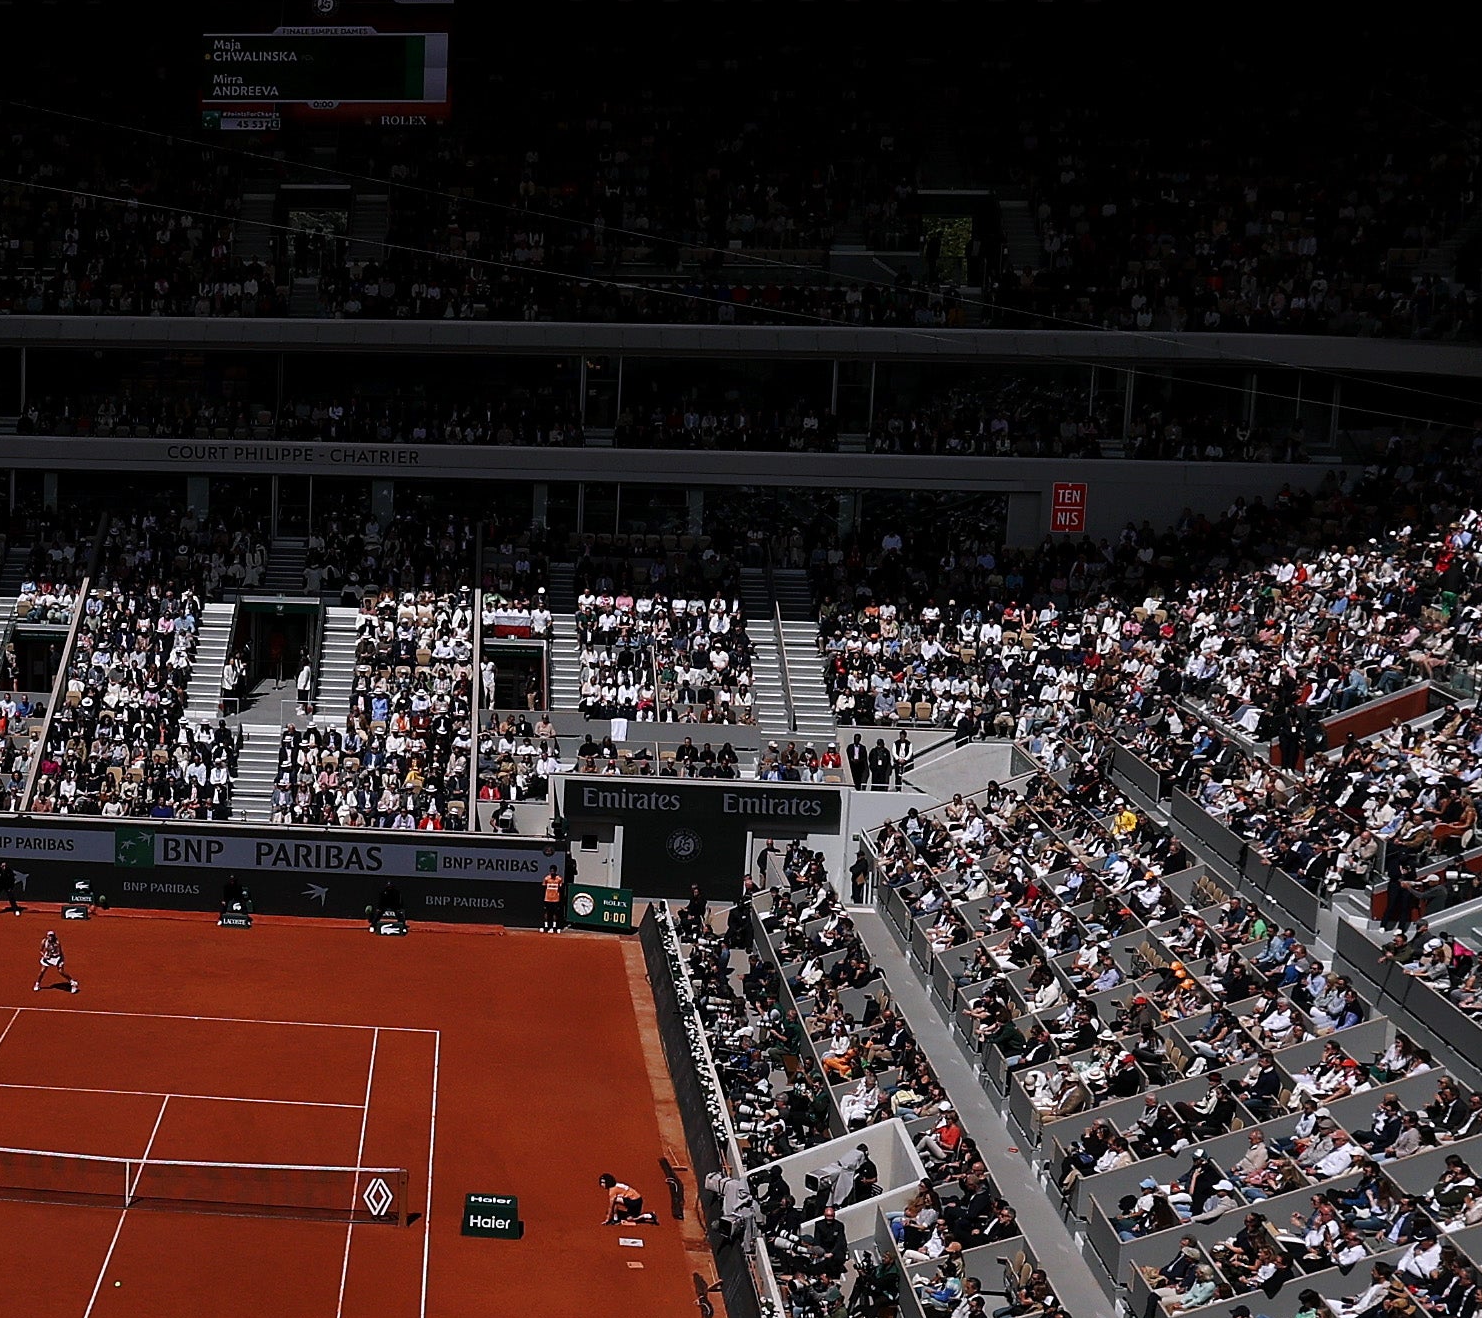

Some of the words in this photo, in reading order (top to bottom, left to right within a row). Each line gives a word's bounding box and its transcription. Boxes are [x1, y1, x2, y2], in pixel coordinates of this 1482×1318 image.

[213, 40, 241, 51] Maja
[213, 51, 298, 62] CHWALINSKA
[213, 74, 243, 84] Mirra
[212, 86, 280, 96] ANDREEVA
[381, 115, 427, 126] ROLEX
[167, 445, 229, 461] COURT
[234, 446, 314, 462] PHILIPPE
[330, 449, 420, 464] CHATRIER
[1057, 489, 1081, 503] TEN
[1056, 511, 1079, 526] NIS
[583, 787, 681, 811] Emirates
[722, 793, 823, 817] Emirates
[15, 835, 75, 852] PARIBAS
[163, 837, 224, 864] BNP
[255, 841, 384, 873] PARIBAS
[442, 856, 473, 870] BNP
[476, 858, 539, 874] PARIBAS
[122, 881, 148, 893] BNP
[150, 882, 200, 895] PARIBAS
[425, 894, 450, 906] BNP
[453, 896, 505, 910] PARIBAS
[602, 899, 627, 908] ROLEX
[603, 911, 626, 924] 0:00
[470, 1194, 513, 1205] Haier
[469, 1214, 512, 1230] Haier
